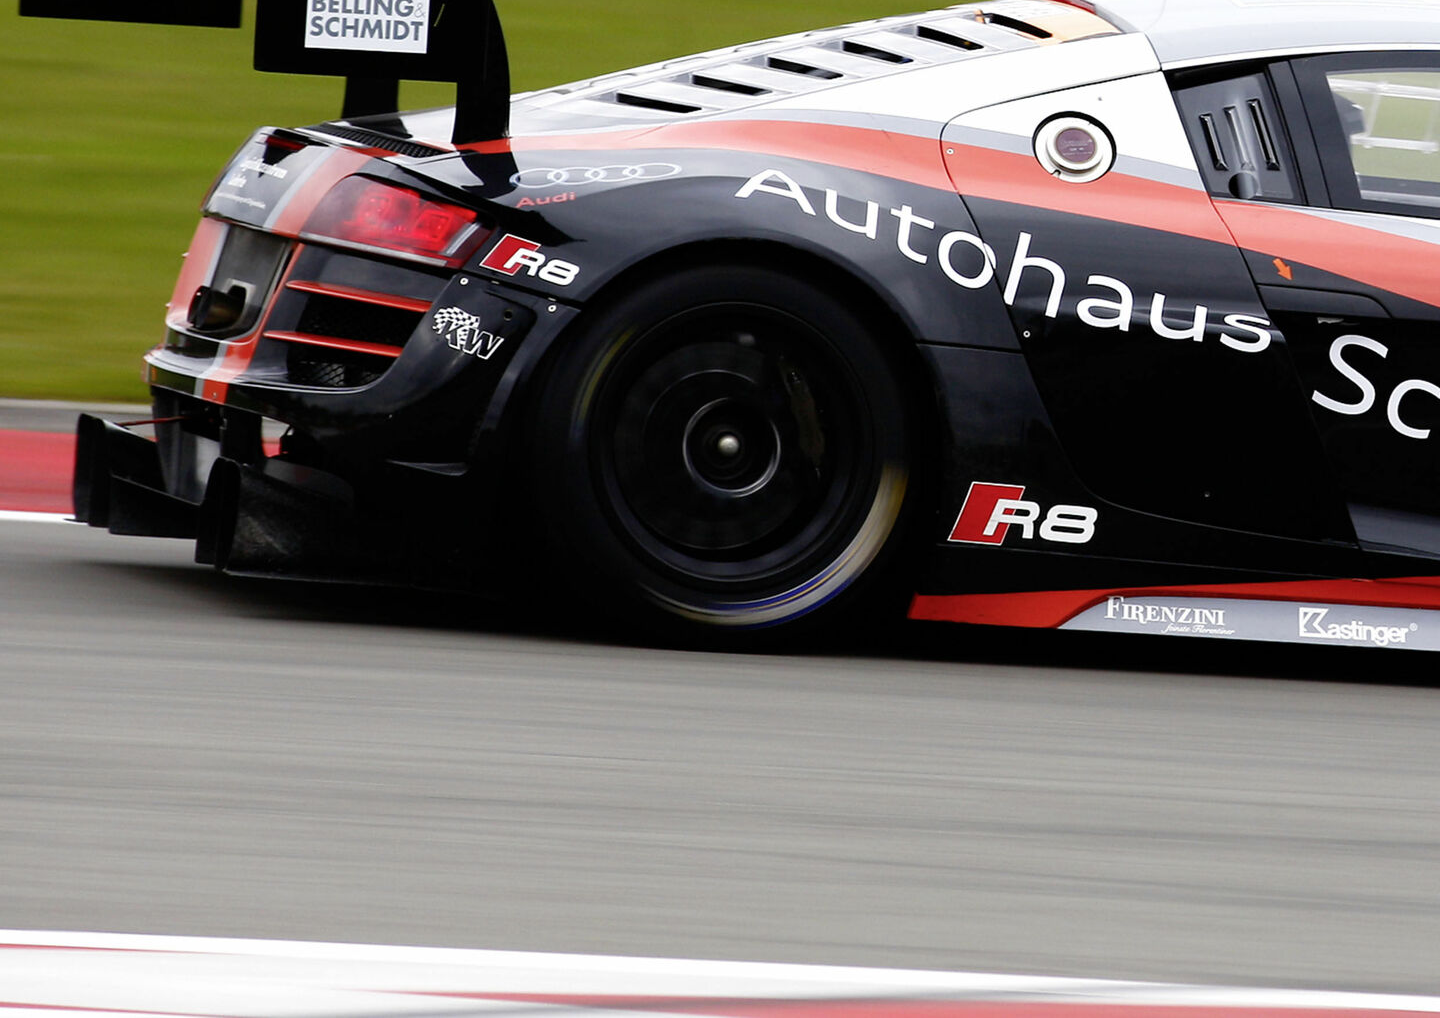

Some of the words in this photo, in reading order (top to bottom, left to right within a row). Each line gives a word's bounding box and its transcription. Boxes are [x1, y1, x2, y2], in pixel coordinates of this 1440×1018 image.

[310, 16, 424, 41] SCHMIDT
[515, 192, 577, 209] Audi
[502, 247, 580, 286] R8
[735, 169, 1273, 353] Autohaus
[983, 497, 1099, 545] R8
[1104, 596, 1226, 625] FIRENZINI
